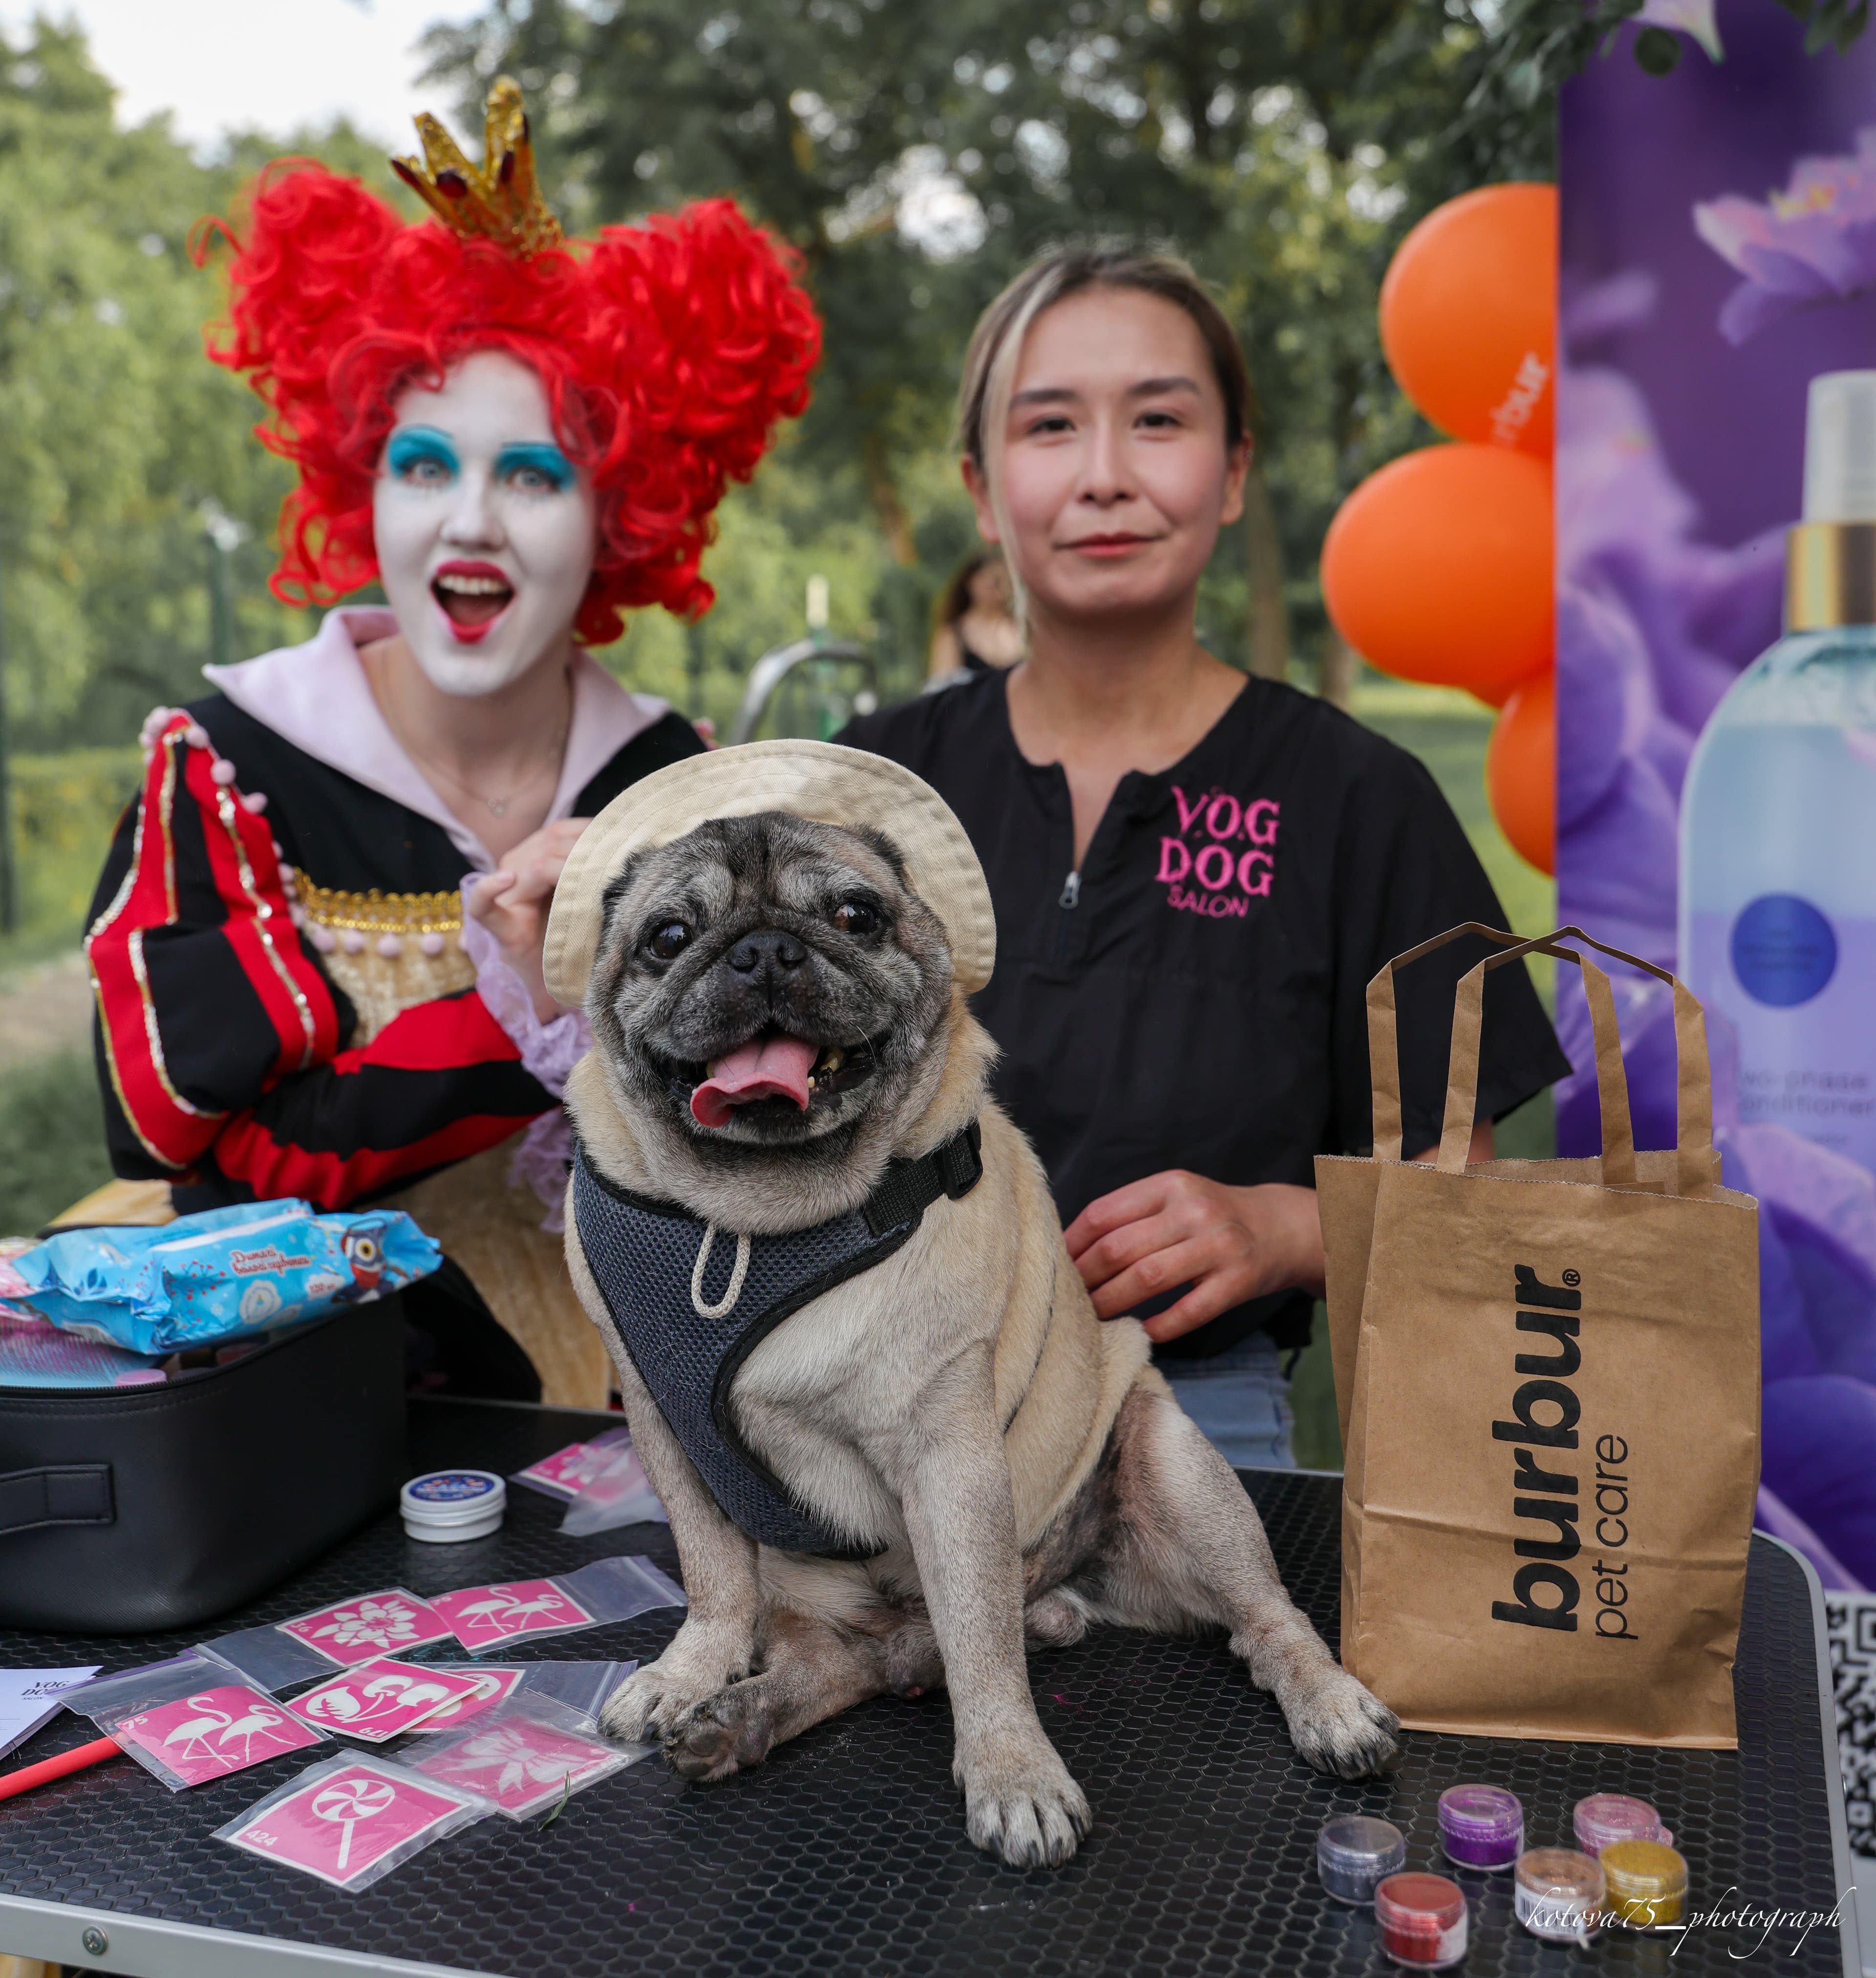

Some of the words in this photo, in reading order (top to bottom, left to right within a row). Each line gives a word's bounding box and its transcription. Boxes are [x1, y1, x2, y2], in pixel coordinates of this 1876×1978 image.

[1154, 836, 1275, 898] DOG
[1167, 884, 1249, 918] SALON
[1738, 1094, 1876, 1119] onditioner
[1596, 1434, 1628, 1547] care
[1592, 1559, 1638, 1640] pet
[290, 1622, 313, 1632] 36
[122, 1715, 149, 1730] 75
[358, 1727, 389, 1738] 179
[246, 1829, 279, 1847] 424
